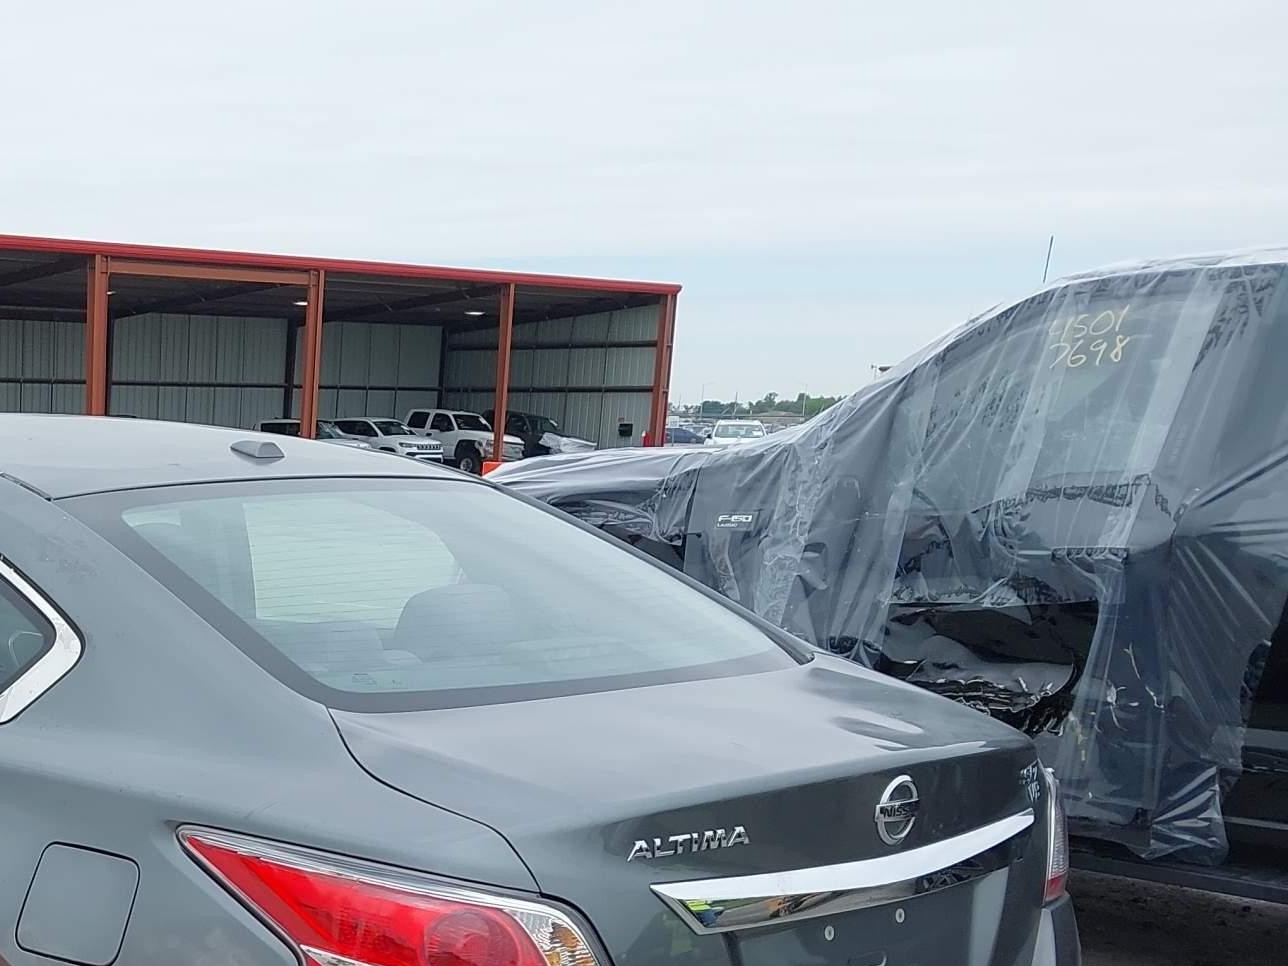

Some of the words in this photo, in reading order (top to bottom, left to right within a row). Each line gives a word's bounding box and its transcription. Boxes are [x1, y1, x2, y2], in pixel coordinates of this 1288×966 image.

[1048, 303, 1130, 343] 4501
[1049, 334, 1130, 369] 7698
[626, 825, 750, 862] ALTIMA
